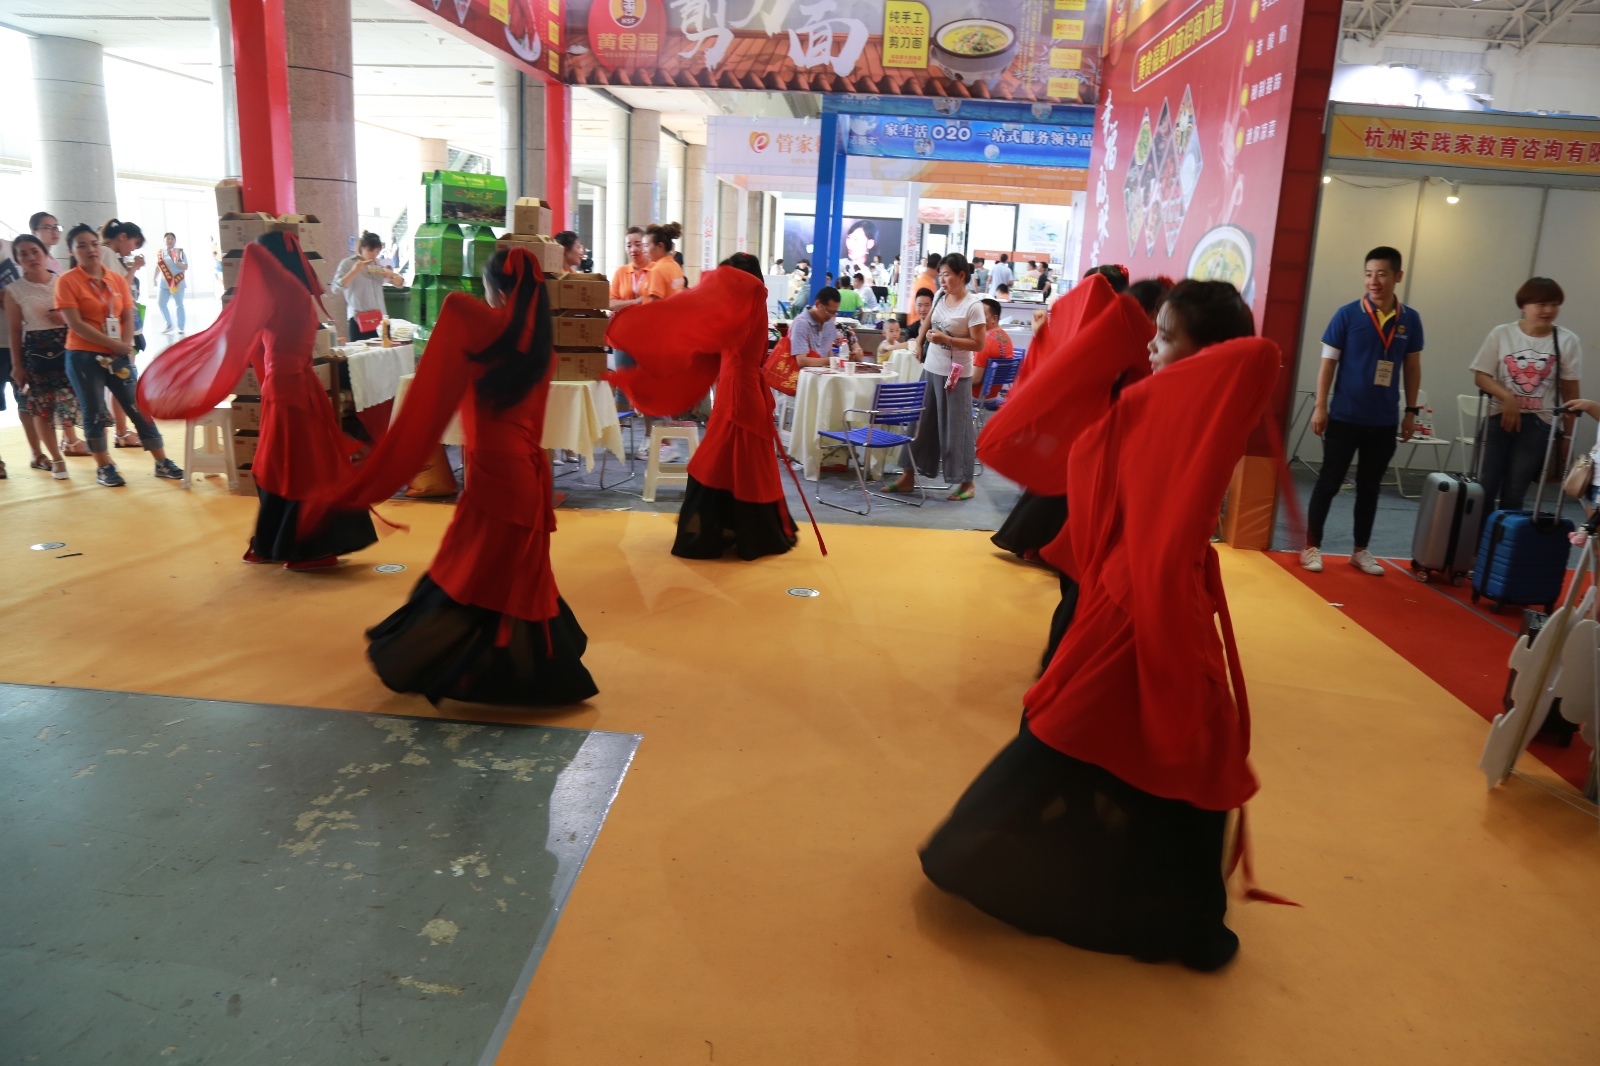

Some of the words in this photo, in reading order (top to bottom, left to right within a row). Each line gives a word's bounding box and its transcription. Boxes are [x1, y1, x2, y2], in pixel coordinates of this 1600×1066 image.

[889, 11, 923, 24] 纯手工
[889, 25, 925, 36] NOODLES
[888, 36, 923, 49] 剪刀面
[884, 122, 928, 139] 家生活
